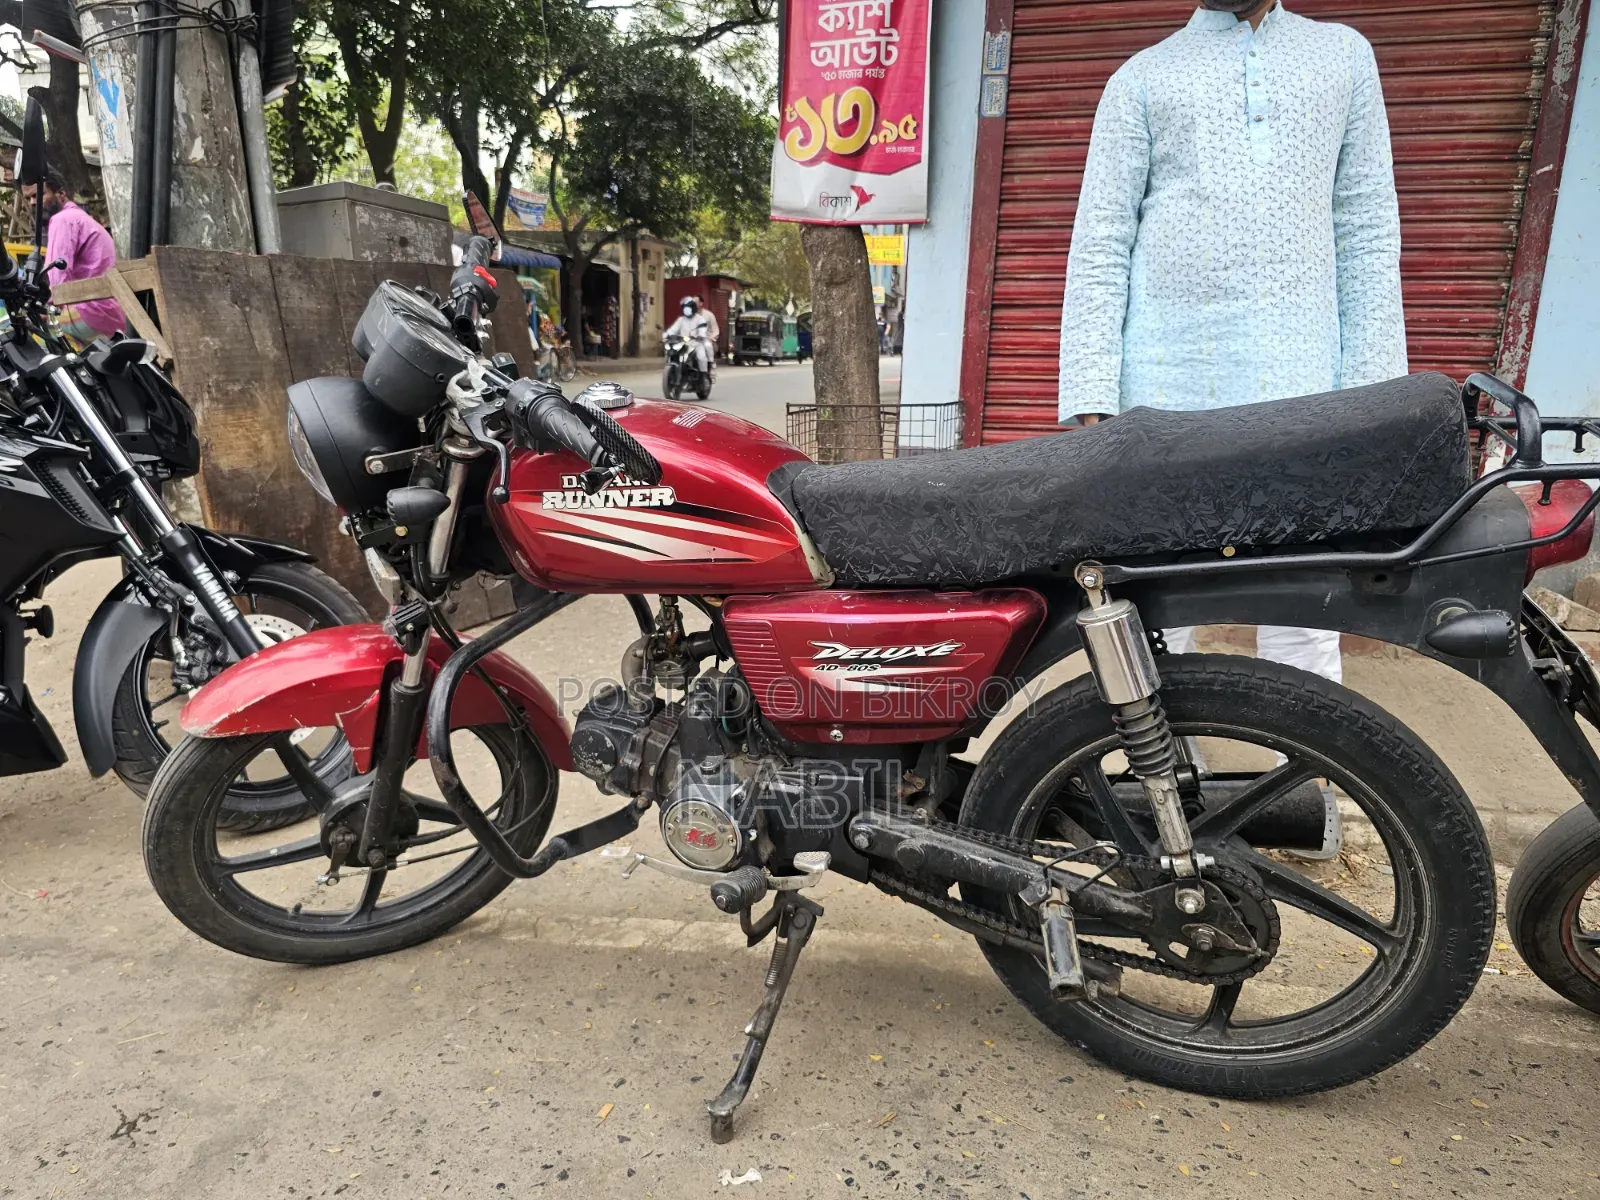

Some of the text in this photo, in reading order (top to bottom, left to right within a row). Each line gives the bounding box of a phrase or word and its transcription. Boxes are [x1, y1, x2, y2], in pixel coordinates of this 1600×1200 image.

[818, 0, 893, 33] ক্যাশ
[810, 28, 900, 68] আউট
[819, 191, 852, 208] বিকাশ
[542, 486, 675, 510] RUNNER
[193, 562, 240, 623] YAMAHA
[810, 639, 963, 663] DELUXE
